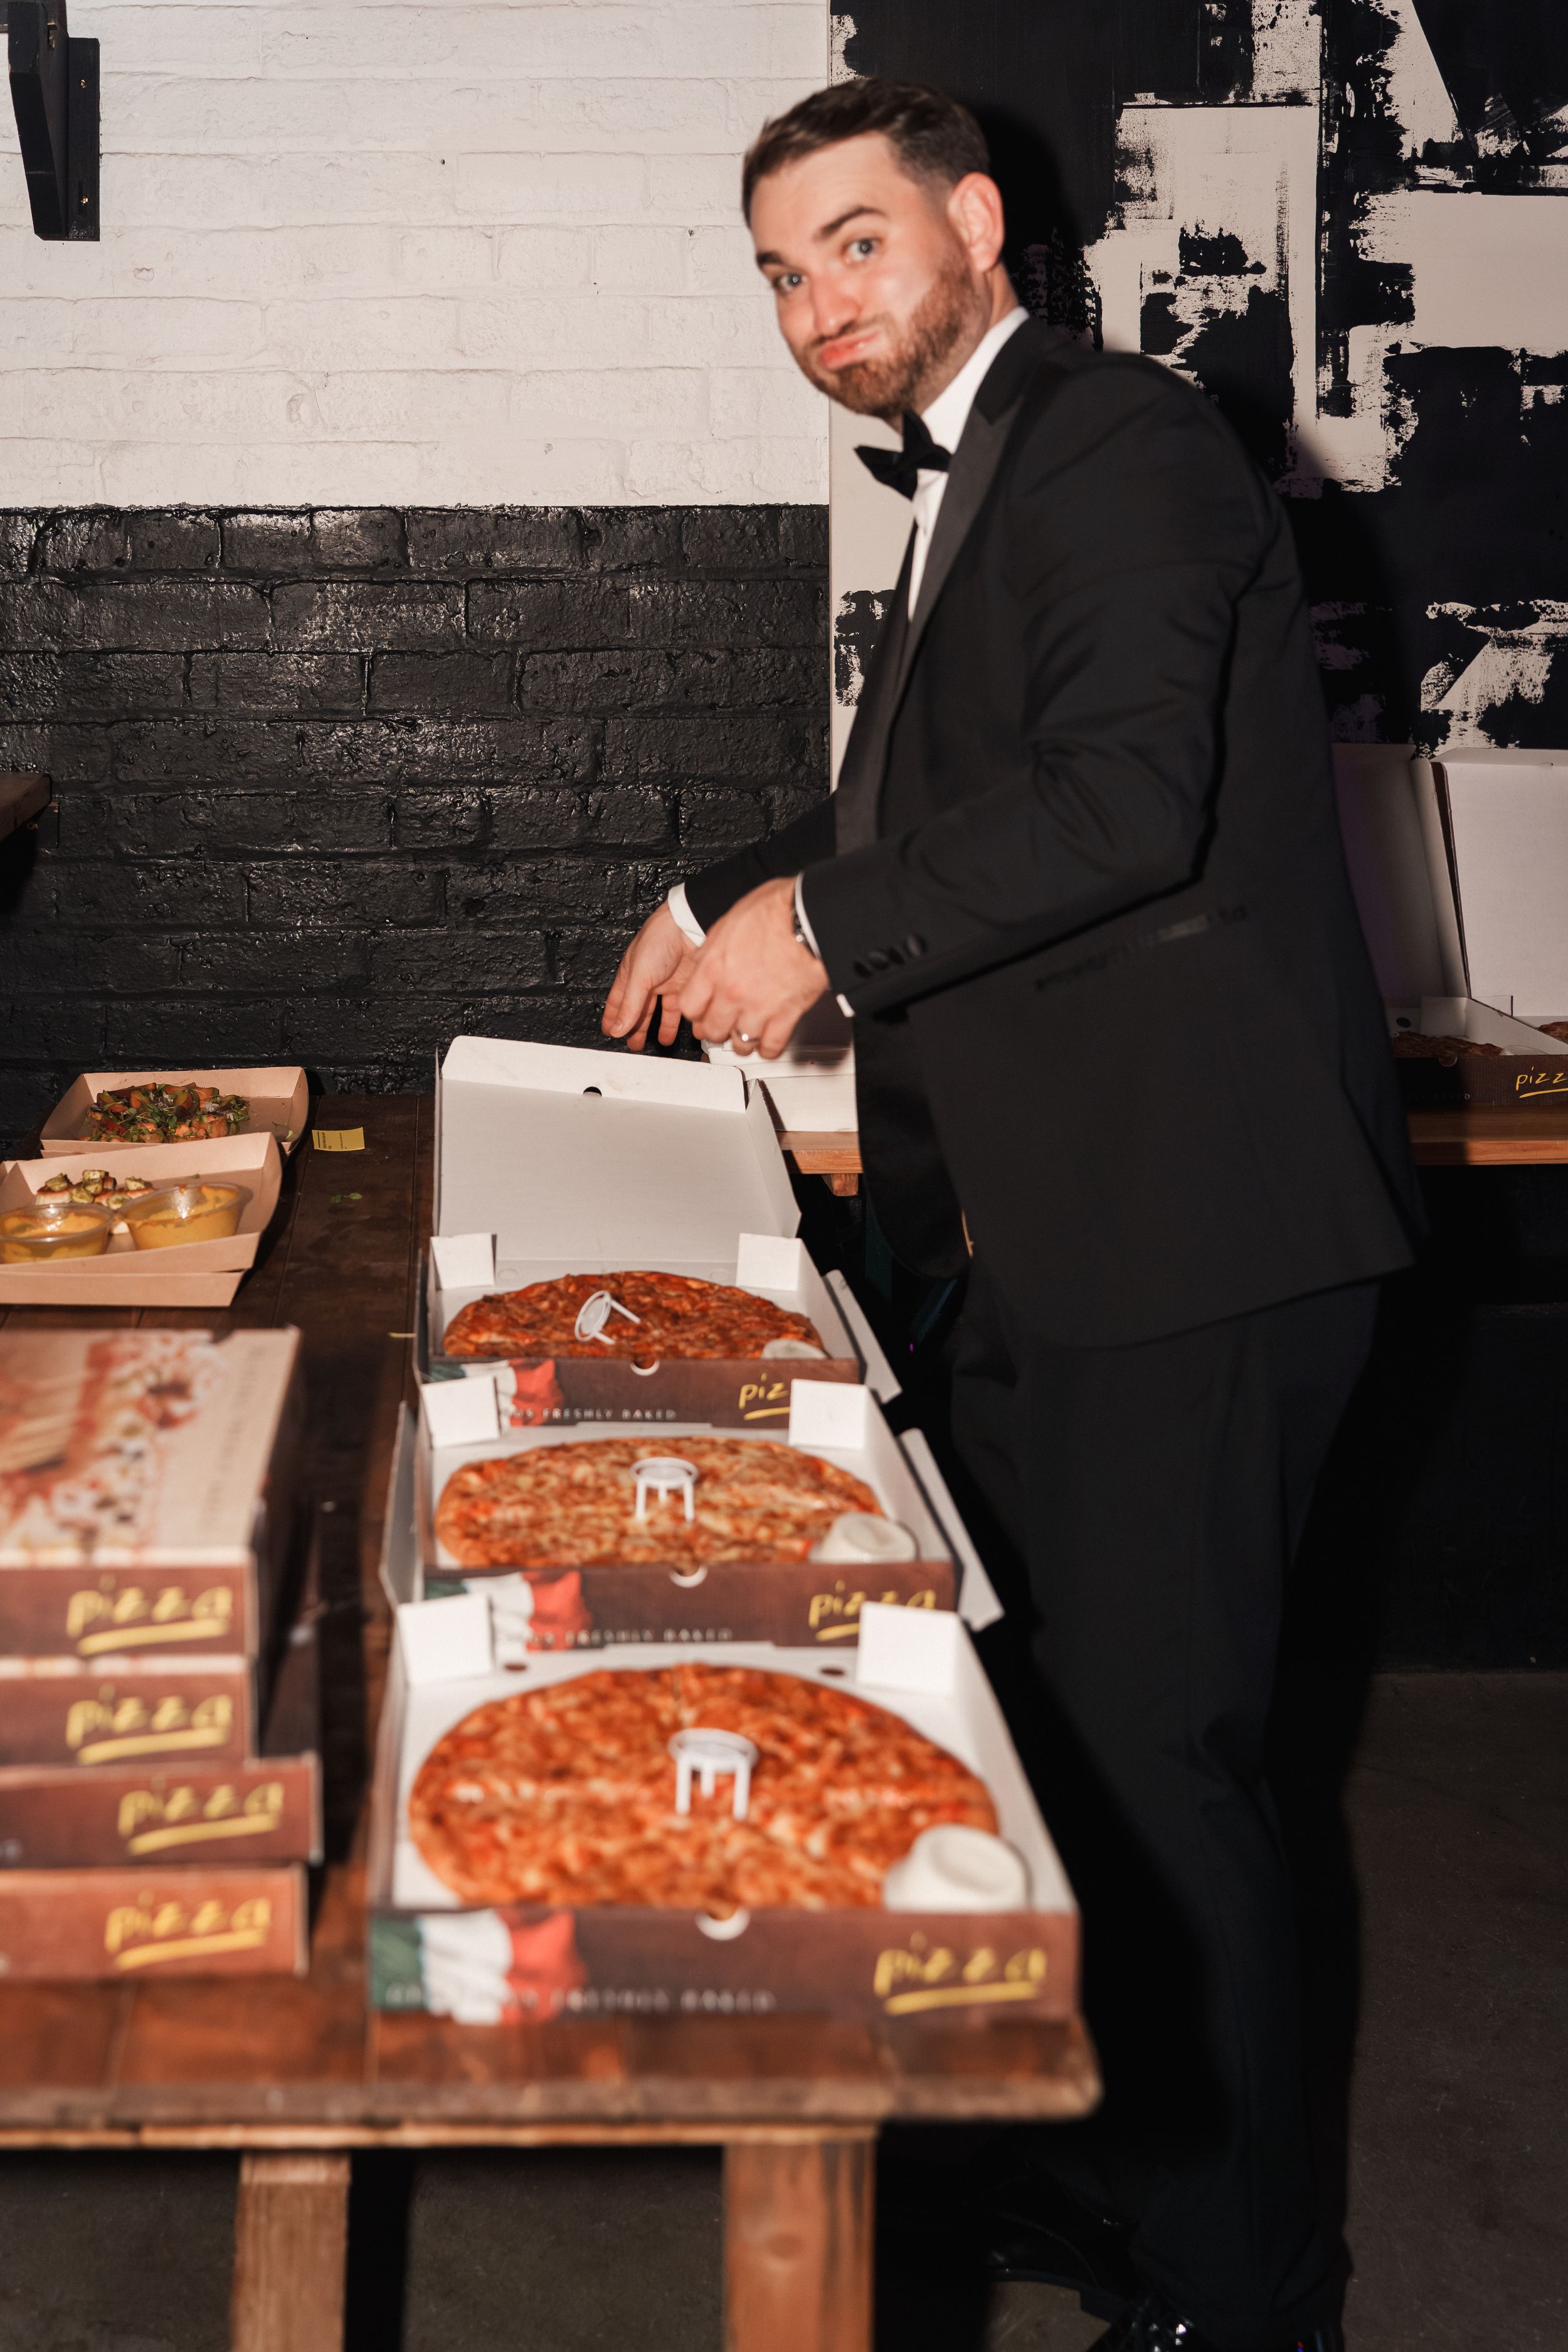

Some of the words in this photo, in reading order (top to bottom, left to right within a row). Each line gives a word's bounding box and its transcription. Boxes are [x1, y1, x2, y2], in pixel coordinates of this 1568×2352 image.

[1515, 1065, 1567, 1091] pizz
[543, 1407, 613, 1420] FRESHLY
[622, 1408, 677, 1419] BAKED
[738, 1372, 790, 1410] piz
[66, 1574, 233, 1639] pizza
[65, 1683, 233, 1750] pizza
[117, 1774, 285, 1838] pizza
[105, 1889, 271, 1954] pizza
[873, 1931, 1046, 1998] pizza
